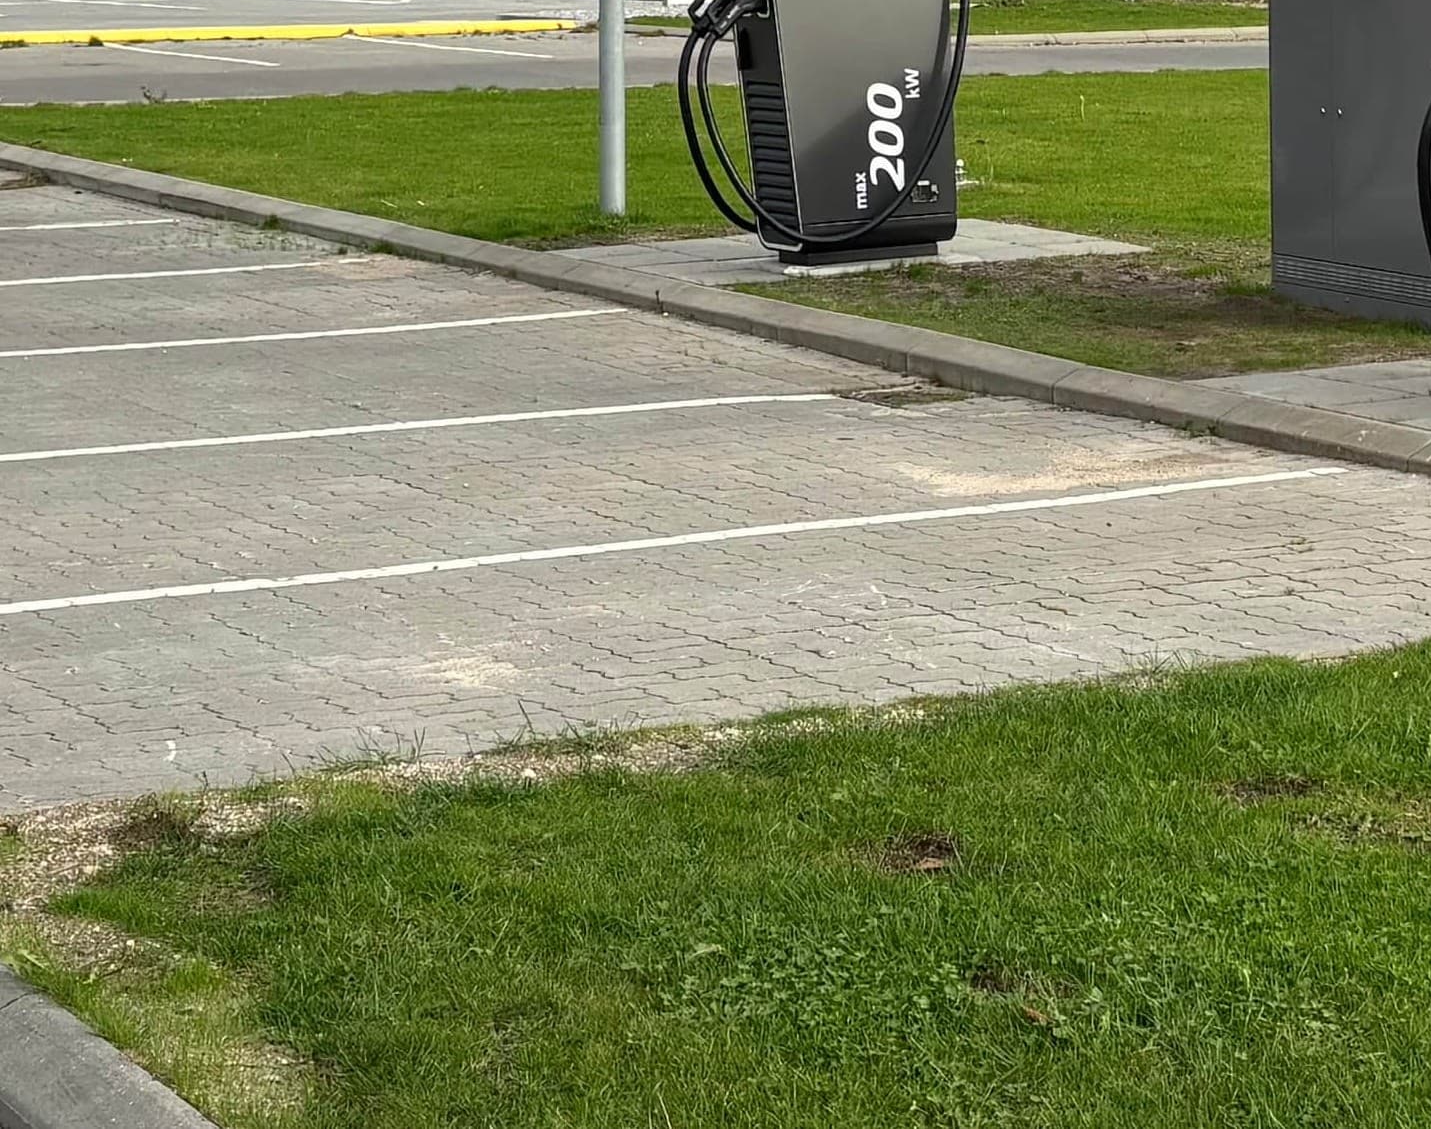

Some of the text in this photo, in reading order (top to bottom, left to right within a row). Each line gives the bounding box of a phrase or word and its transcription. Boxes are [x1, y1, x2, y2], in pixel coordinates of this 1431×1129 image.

[904, 68, 920, 99] kW
[867, 82, 905, 191] 200
[855, 172, 869, 209] max
